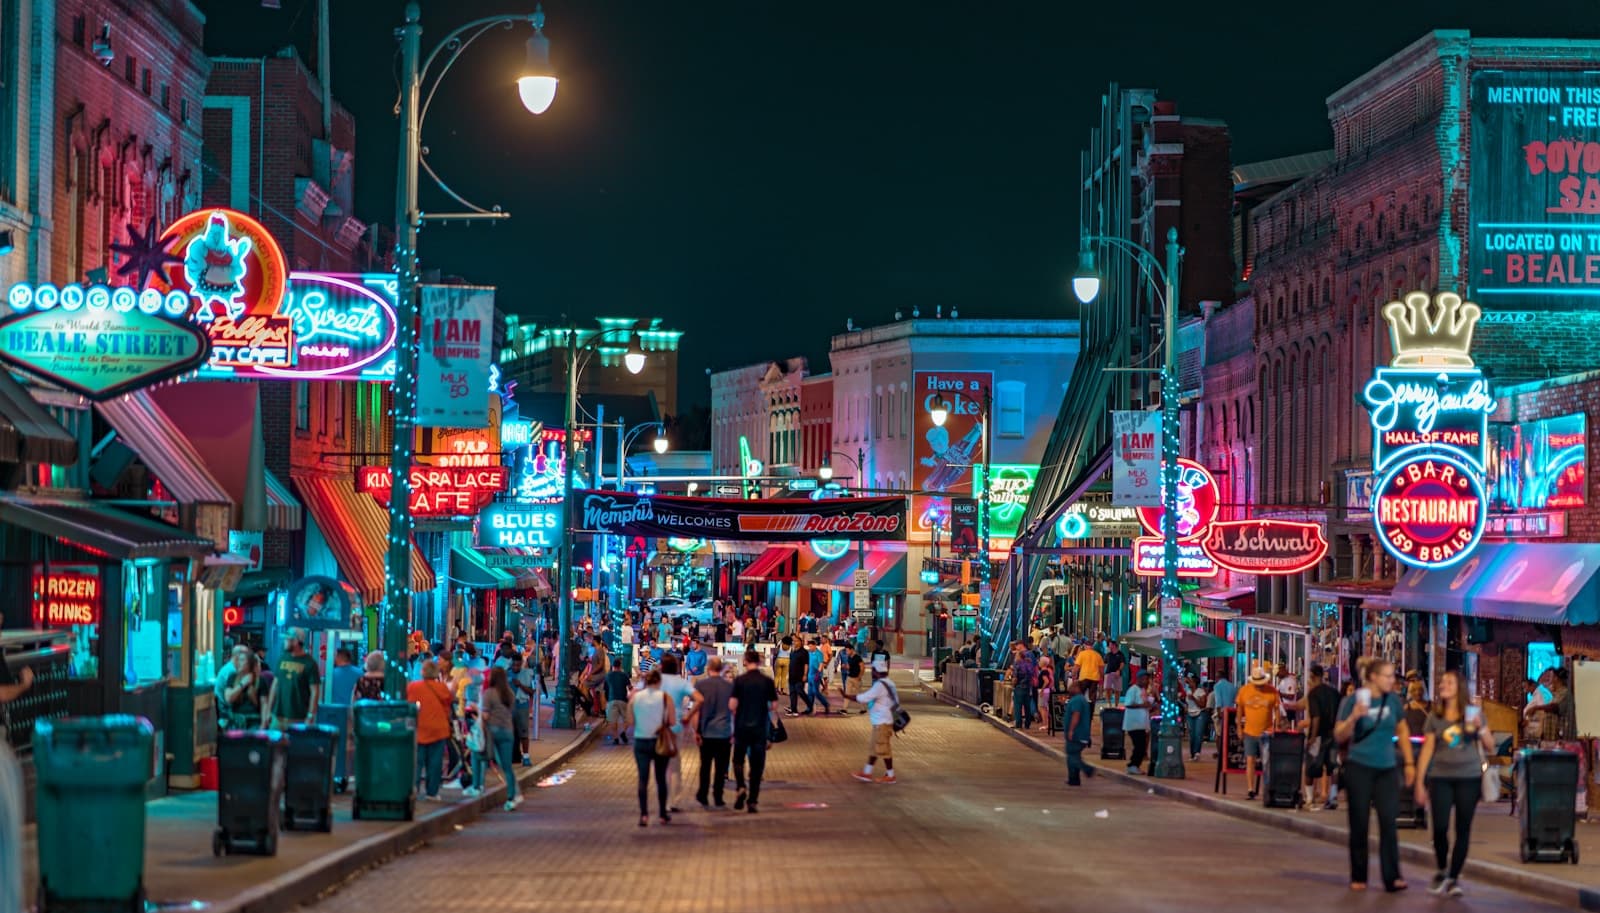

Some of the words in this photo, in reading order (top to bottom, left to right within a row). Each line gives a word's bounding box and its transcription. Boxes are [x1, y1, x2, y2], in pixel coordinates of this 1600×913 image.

[1488, 87, 1560, 103] MENTION
[1566, 87, 1600, 103] THIS
[1563, 108, 1600, 127] FRE
[1485, 234, 1555, 250] LOCATED
[1560, 234, 1583, 250] ON
[1506, 254, 1600, 283] BEALE
[296, 291, 381, 343] Sweets
[1482, 312, 1528, 322] MAR
[433, 318, 441, 342] I
[446, 319, 481, 342] AM
[8, 331, 87, 354] BEALE
[96, 333, 188, 356] STREET
[237, 347, 286, 364] CAFE
[433, 346, 481, 358] MEMPHIS
[441, 372, 467, 383] MLK
[927, 375, 964, 391] Have
[970, 380, 980, 391] a
[1122, 433, 1127, 449] I
[1131, 433, 1154, 449] AM
[1385, 432, 1420, 444] HALL
[1423, 433, 1440, 444] OF
[1443, 432, 1479, 444] FAME
[454, 440, 488, 453] TAP
[1405, 460, 1456, 485] BAR
[410, 491, 471, 510] AFE
[583, 504, 654, 529] Memphis
[657, 514, 731, 528] WELCOMES
[803, 512, 900, 532] AutoZone
[1380, 498, 1479, 524] RESTAURANT
[492, 513, 557, 528] BLUES
[500, 530, 550, 546] HALL
[1208, 526, 1231, 551] A.
[1234, 526, 1320, 551] Schwab
[1387, 528, 1414, 552] 159
[1419, 527, 1474, 561] BEALE
[490, 555, 517, 567] JUKE
[521, 555, 549, 567] JOINT
[855, 579, 868, 587] 25
